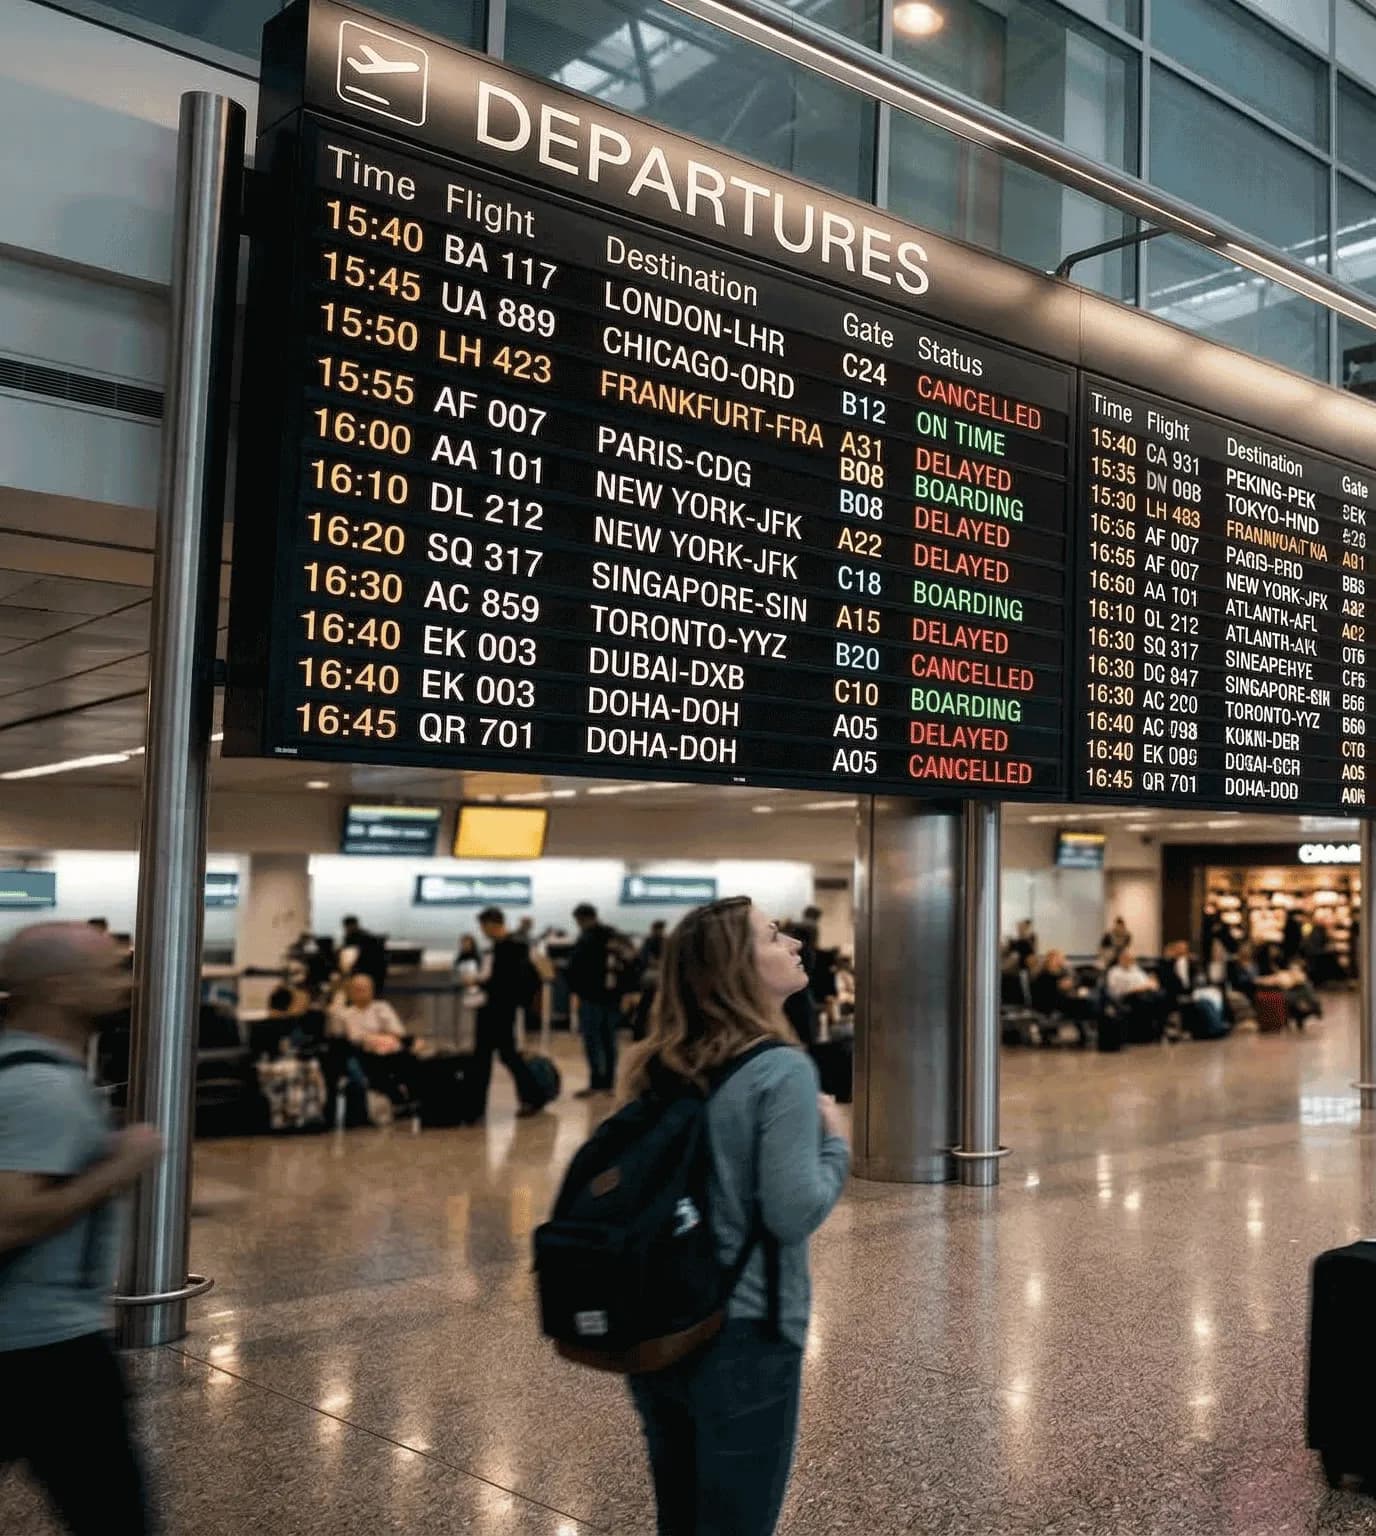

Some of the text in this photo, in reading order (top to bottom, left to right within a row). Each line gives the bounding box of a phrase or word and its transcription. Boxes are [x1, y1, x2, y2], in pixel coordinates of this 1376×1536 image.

[475, 79, 930, 295] DEPARTURES
[327, 144, 983, 377] Time Flight Destination Gate Status
[327, 200, 1041, 430] 15:40 BA 117 LONDON-LHR C24 CANCELLED
[323, 251, 1005, 457] 15:45 UA 889 CHICAGO-ORD B12 ON TIME
[320, 302, 1012, 492] 15:50 LH 423 FRANKFURT-FRA A31 DELAYED
[1091, 391, 1133, 424] Time
[1147, 410, 1190, 443] Flight
[1227, 436, 1303, 478] Destination
[318, 357, 1024, 522] 15:55 AF 007 PARIS-CDG B08 BOARDING
[1091, 427, 1137, 457] 15:40
[1146, 443, 1168, 467] CA
[1172, 451, 1199, 476] 931
[1226, 467, 1316, 511] PEKING-PEK
[314, 408, 1010, 548] 16:00 AA 101 NEW YORK-JFK B08 DELAYED
[1091, 455, 1136, 485] 15:35
[1225, 493, 1319, 535] TOKYO-HND
[1091, 483, 1136, 512] 15:30
[1146, 497, 1167, 521] LH
[311, 459, 1009, 584] 16:10 DL 212 NEW YORK-JFK A22 DELAYED
[1144, 526, 1166, 547] AF
[1170, 531, 1200, 555] 007
[307, 512, 1023, 623] 16:20 SQ 317 SINGAPORE-SIN C18 BOARDING
[1143, 580, 1166, 602] AA
[1171, 586, 1197, 607] 101
[1144, 553, 1166, 574] AF
[1170, 559, 1200, 582] 007
[1226, 571, 1260, 595] NEW
[303, 562, 1009, 659] 16:30 AC 859 TORONTO-YYZ A15 DELAYED
[1088, 626, 1135, 652] 16:30
[1143, 635, 1166, 658] SQ
[1170, 639, 1199, 661] 317
[1089, 598, 1135, 624] 16:10
[1170, 613, 1199, 635] 212
[301, 610, 1034, 691] 16:40 EK 003 DUBAI-DXB B20 CANCELLED
[1088, 653, 1135, 679] 16:30
[298, 657, 1021, 727] 16:40 EK 003 DOHA-DOH C10 BOARDING
[1086, 711, 1134, 734] 16:40
[1142, 716, 1165, 738] AC
[1087, 682, 1134, 707] 16:30
[1142, 689, 1165, 711] AC
[1224, 700, 1321, 729] TORONTO-YYZ
[296, 702, 1009, 764] 16:45 QR 701 DOHA-DOH A05 DELAYED
[832, 748, 1032, 784] A05 CANCELLED
[1086, 739, 1134, 762] 16:40
[1143, 743, 1164, 765] EK
[1086, 767, 1133, 789] 16:45
[1142, 771, 1165, 792] QR
[1169, 773, 1196, 793] 701
